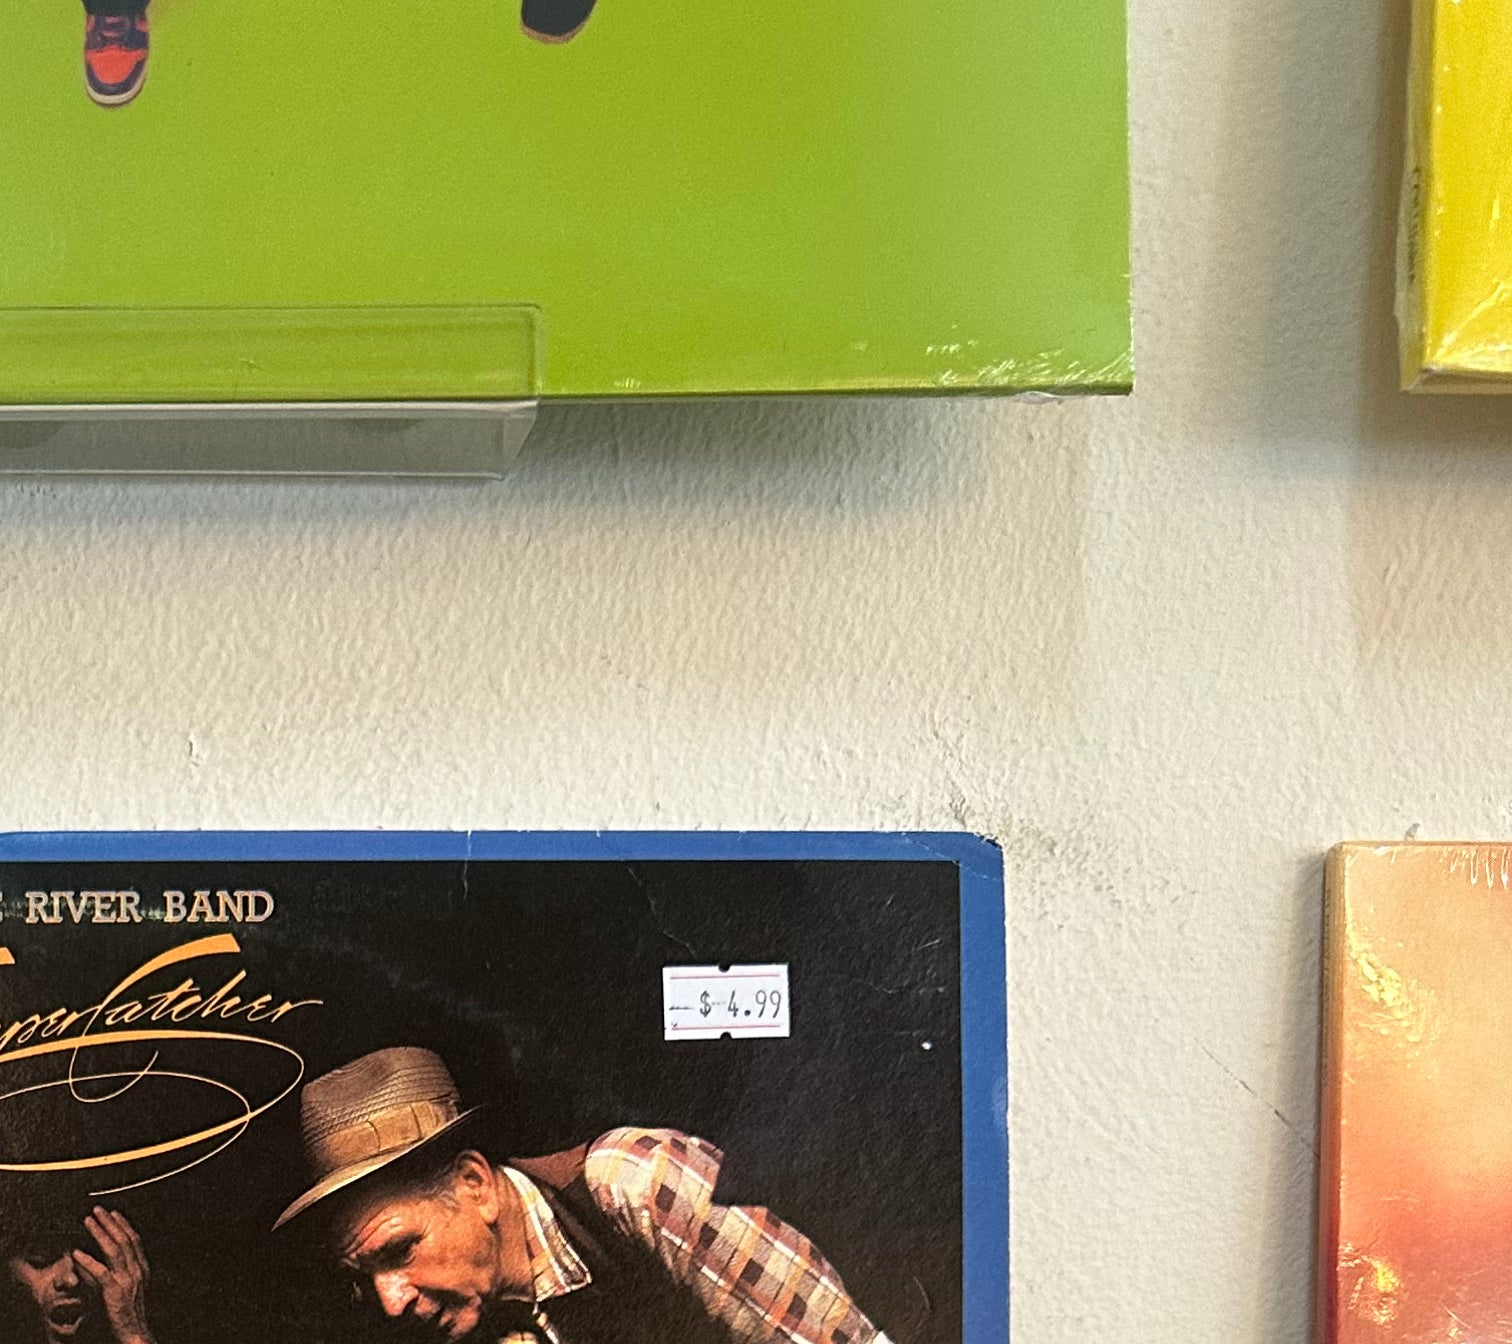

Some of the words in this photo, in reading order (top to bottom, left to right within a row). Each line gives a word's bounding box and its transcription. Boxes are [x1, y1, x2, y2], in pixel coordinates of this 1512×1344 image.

[25, 890, 142, 925] RIVER
[164, 889, 275, 924] BAND
[73, 932, 325, 1085] Catcher
[727, 989, 782, 1018] 4.99
